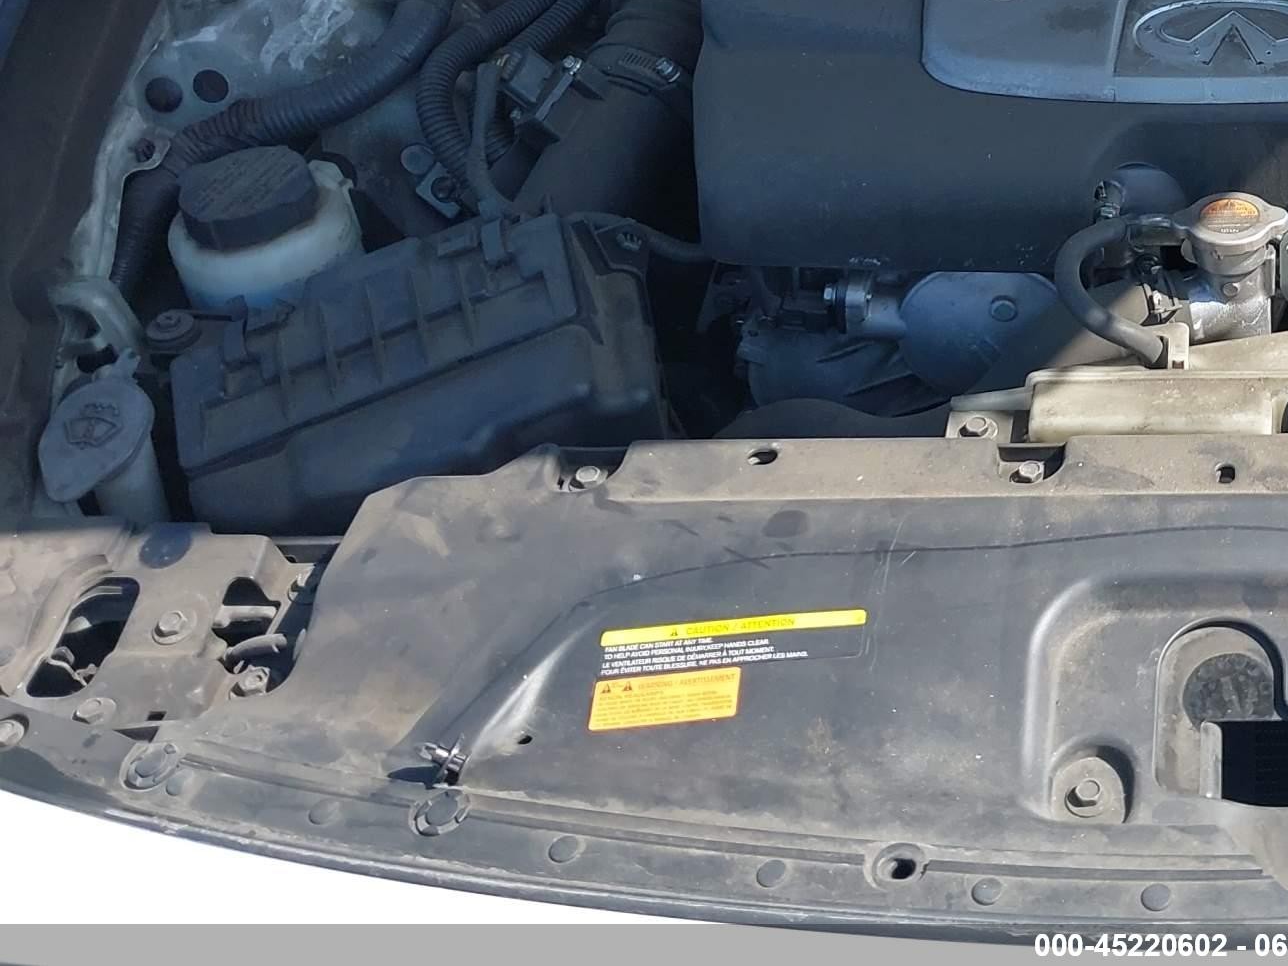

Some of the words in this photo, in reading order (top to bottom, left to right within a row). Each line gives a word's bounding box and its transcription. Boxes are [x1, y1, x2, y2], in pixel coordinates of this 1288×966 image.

[685, 622, 730, 635] CAUTION
[740, 617, 796, 629] ATTENTION
[613, 651, 631, 659] HELP
[630, 650, 650, 658] AVOID
[650, 647, 684, 656] PERSONAL
[724, 641, 747, 649] HANDS
[618, 644, 639, 652] BLADE
[654, 640, 674, 648] START
[600, 668, 620, 676] POUR
[620, 665, 642, 675] ÉVITER
[642, 664, 663, 672] TOUTE
[708, 657, 722, 665] PAS
[722, 655, 732, 663] EN
[732, 652, 773, 663] APPROCHER
[772, 652, 786, 660] LES
[611, 657, 651, 668] VENTILATEUR
[651, 655, 677, 664] RISQUE
[676, 654, 686, 662] DE
[686, 650, 723, 661] DÉMARRER
